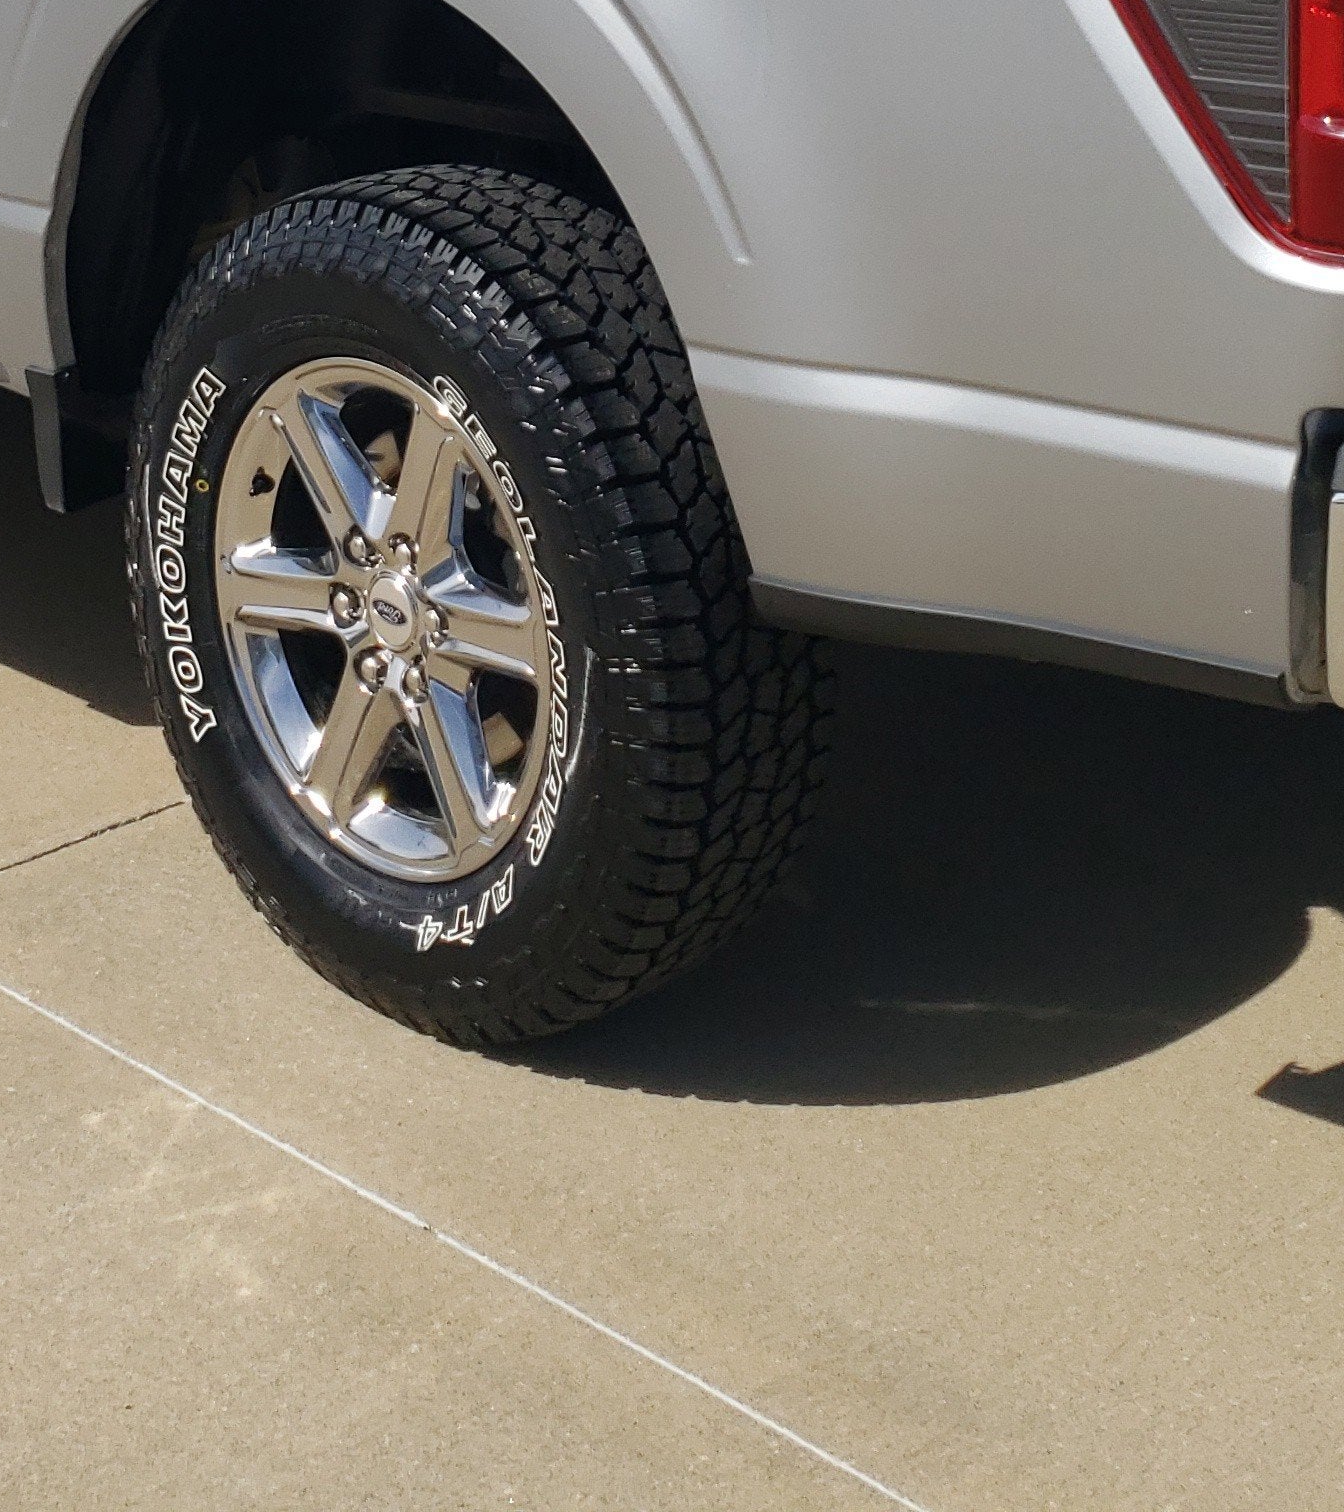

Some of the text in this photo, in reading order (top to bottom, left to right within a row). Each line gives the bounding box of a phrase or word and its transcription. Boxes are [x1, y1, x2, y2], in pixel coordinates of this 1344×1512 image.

[155, 369, 226, 742] YOKOHAMA
[416, 374, 570, 952] GEOLANDAR A/T4
